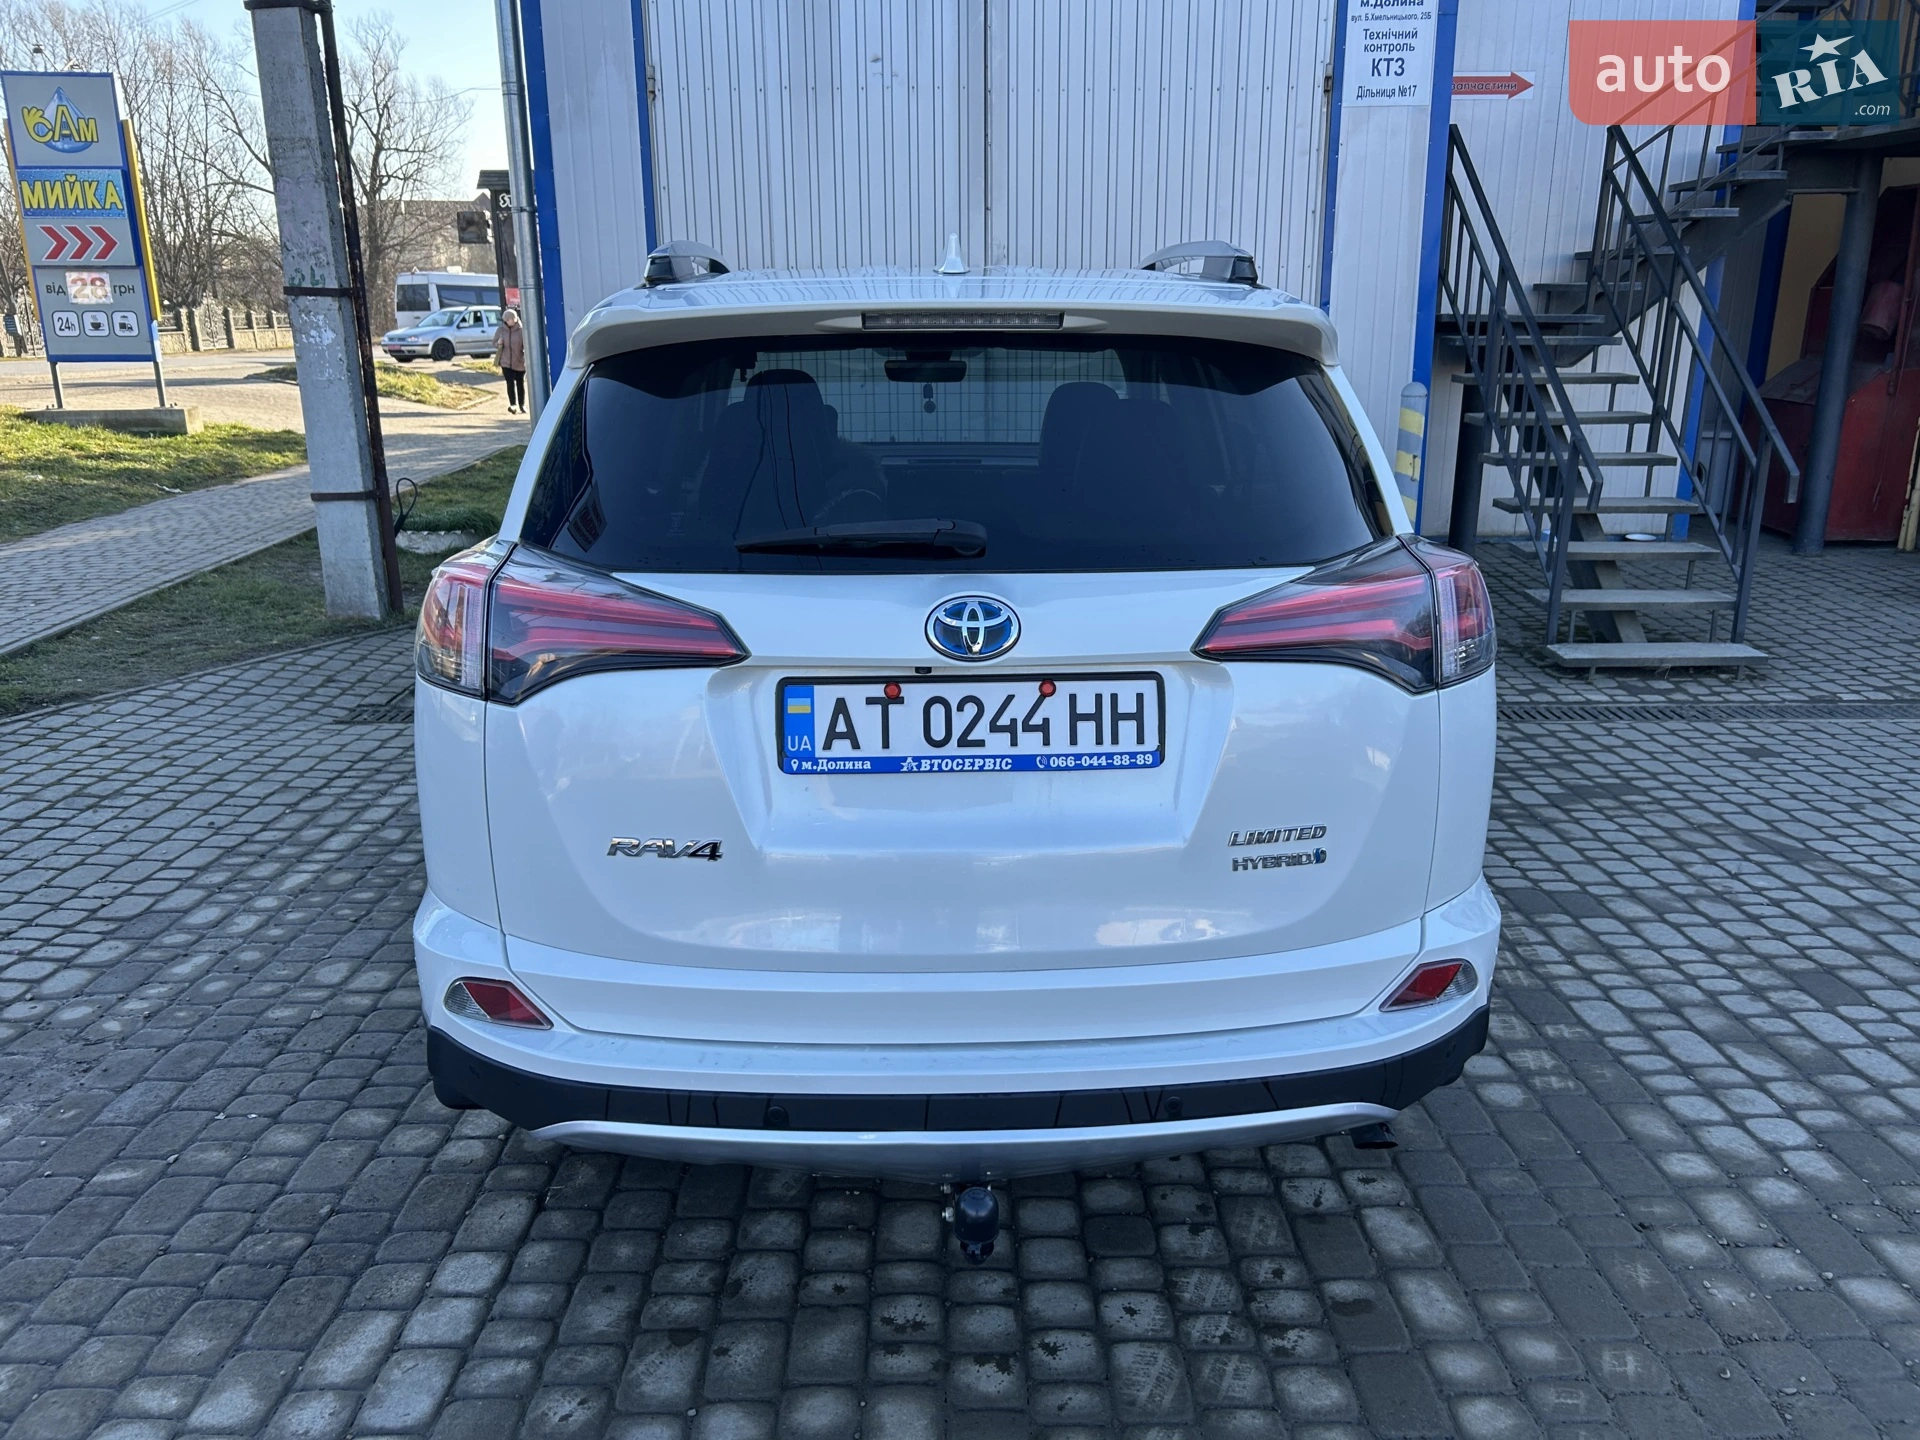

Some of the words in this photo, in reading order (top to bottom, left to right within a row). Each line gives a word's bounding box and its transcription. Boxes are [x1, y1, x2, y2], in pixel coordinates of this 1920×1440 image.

[1363, 27, 1418, 40] Технічний
[1363, 42, 1415, 54] контроль
[1371, 57, 1406, 77] КТЗ
[1356, 85, 1396, 100] Дільниця
[1397, 84, 1417, 98] №17
[1452, 82, 1517, 91] запчастини
[20, 173, 124, 210] МИЙКА
[45, 282, 66, 296] від
[70, 276, 108, 300] 28
[113, 284, 136, 296] грн
[57, 316, 76, 332] 24h
[822, 696, 905, 751] AT
[922, 693, 1050, 749] 0244
[1068, 691, 1145, 746] HH
[787, 735, 812, 752] UA
[801, 759, 871, 771] м.Долина
[900, 756, 1013, 773] АВТОСЕРВІС
[1050, 754, 1153, 768] 066-044-88-89
[1228, 824, 1327, 846] LIMITED
[607, 836, 723, 861] RAV4
[1232, 852, 1312, 871] HYBRID
